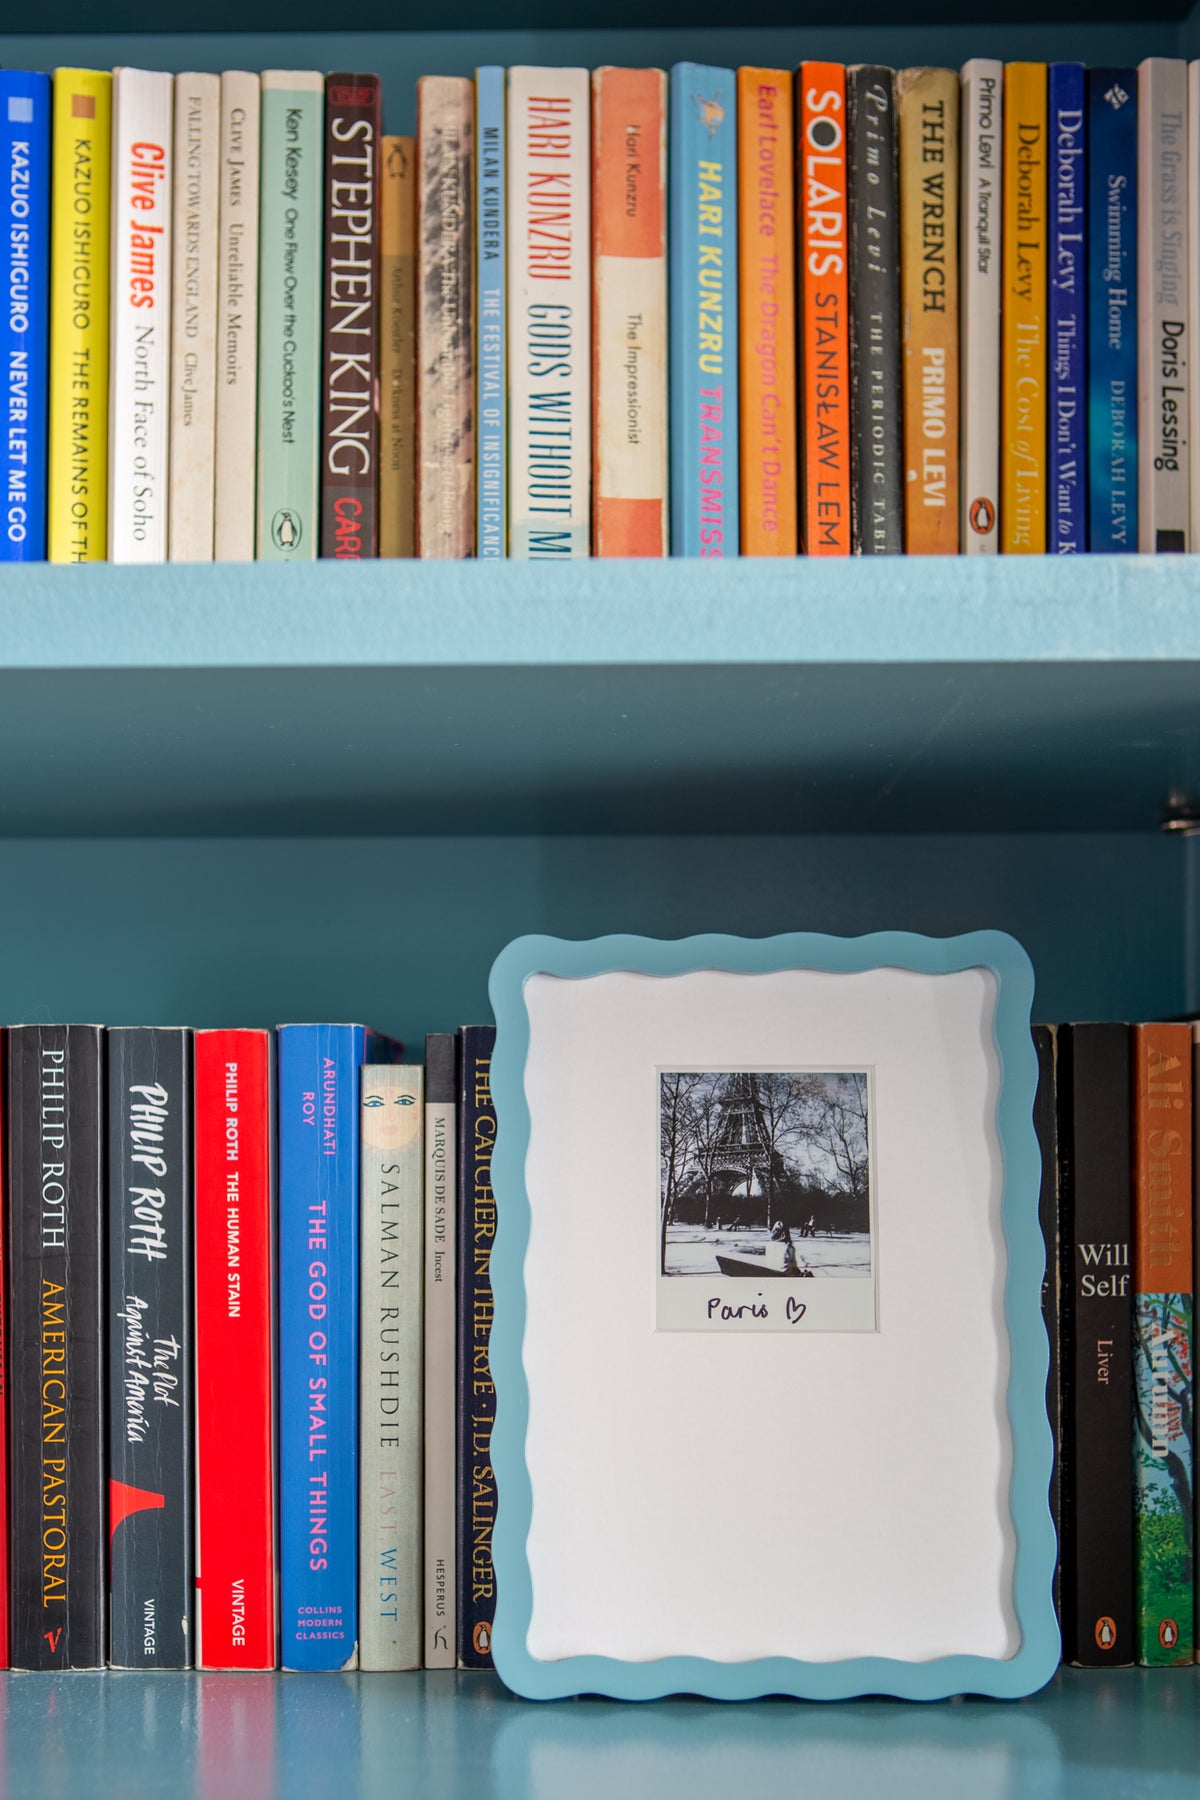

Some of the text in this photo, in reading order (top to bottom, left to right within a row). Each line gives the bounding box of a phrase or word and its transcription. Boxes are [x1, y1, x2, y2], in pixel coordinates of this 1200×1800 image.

[227, 108, 247, 207] CLIVE JAMES
[282, 108, 302, 200] Ken Kesey
[483, 127, 499, 260] MILAN KUNDERA
[528, 96, 572, 279] HARI KUNZRU
[626, 124, 641, 218] Hari Kunzru
[758, 85, 780, 237] Earl Lovelace
[806, 88, 844, 276] SOLARIS
[865, 84, 888, 274] Primo Levi
[979, 77, 995, 170] Primo Levi
[10, 141, 29, 333] KAZUO ISHIGURO
[73, 139, 91, 329] KAZUO ISHIGURO
[129, 142, 165, 309] Clive James
[185, 96, 202, 338] FALLING TOWARDS ENGLAND
[330, 117, 373, 335] STEPHEN
[698, 160, 723, 374] HARI KUNZRU
[922, 101, 945, 314] THE WRENCH
[976, 178, 991, 274] A Tranquil Star
[1011, 122, 1040, 301] Deborah Levy
[1052, 109, 1083, 295] Deborah Levy
[1103, 174, 1127, 350] Swimming Home
[1155, 112, 1183, 305] The Grass is Singing
[227, 223, 244, 385] Unreliable Memoirs
[282, 208, 299, 444] One Flew Over the Cuckoo's Nest
[483, 325, 499, 400] FESTIVAL
[484, 289, 499, 316] THE
[870, 312, 884, 355] THE
[8, 351, 28, 542] NEVER LET ME GO
[71, 348, 89, 530] THE REMAINS OF
[133, 325, 155, 541] North Face of Soho
[181, 352, 198, 427] Clive James
[328, 351, 371, 476] KING
[483, 408, 499, 427] OF
[527, 304, 573, 518] GODS WITHOUT
[624, 313, 642, 444] The Impressionist
[755, 255, 782, 532] The Dragon Can't Dance
[815, 292, 841, 546] STANISŁAW LEM
[871, 370, 885, 485] PERIODIC
[922, 348, 946, 507] PRIMO LEVI
[1010, 313, 1040, 545] The Cost of Living
[1055, 313, 1077, 535] Things I Don't Want to
[1154, 320, 1187, 471] Doris Lessing
[1111, 380, 1127, 544] DEBORAH LEVY
[42, 1050, 65, 1248] PHILIP ROTH
[127, 1082, 169, 1262] PHILIP ROTH
[225, 1063, 238, 1161] PHILIP ROTH
[302, 1092, 315, 1126] ROY
[323, 1057, 336, 1155] ARUNDHATI
[431, 1117, 445, 1244] MARQUIS DE SADE
[1147, 1044, 1185, 1270] Ali Smith
[227, 1172, 240, 1318] THE HUMAN STAIN
[435, 1251, 446, 1282] Incest
[473, 1052, 495, 1395] THE CATCHER IN THE RYE
[1078, 1244, 1129, 1266] Will
[1081, 1274, 1130, 1297] Self
[118, 1295, 151, 1444] Against America
[153, 1334, 181, 1408] The Plot
[380, 1163, 400, 1447] SALMAN RUSHDIE
[707, 1292, 769, 1320] Paris
[1097, 1340, 1113, 1385] Liver
[42, 1279, 66, 1608] AMERICAN PASTORAL
[308, 1201, 327, 1572] THE GOD OF SMALL THINGS
[379, 1548, 397, 1621] WEST
[436, 1559, 446, 1616] HESPERUS
[472, 1465, 494, 1603] SALINGER
[143, 1599, 155, 1655] VINTAGE
[231, 1579, 245, 1646] VINTAGE
[295, 1631, 345, 1640] CLASSICS
[297, 1606, 342, 1615] COLLINS
[297, 1618, 342, 1627] MODERN
